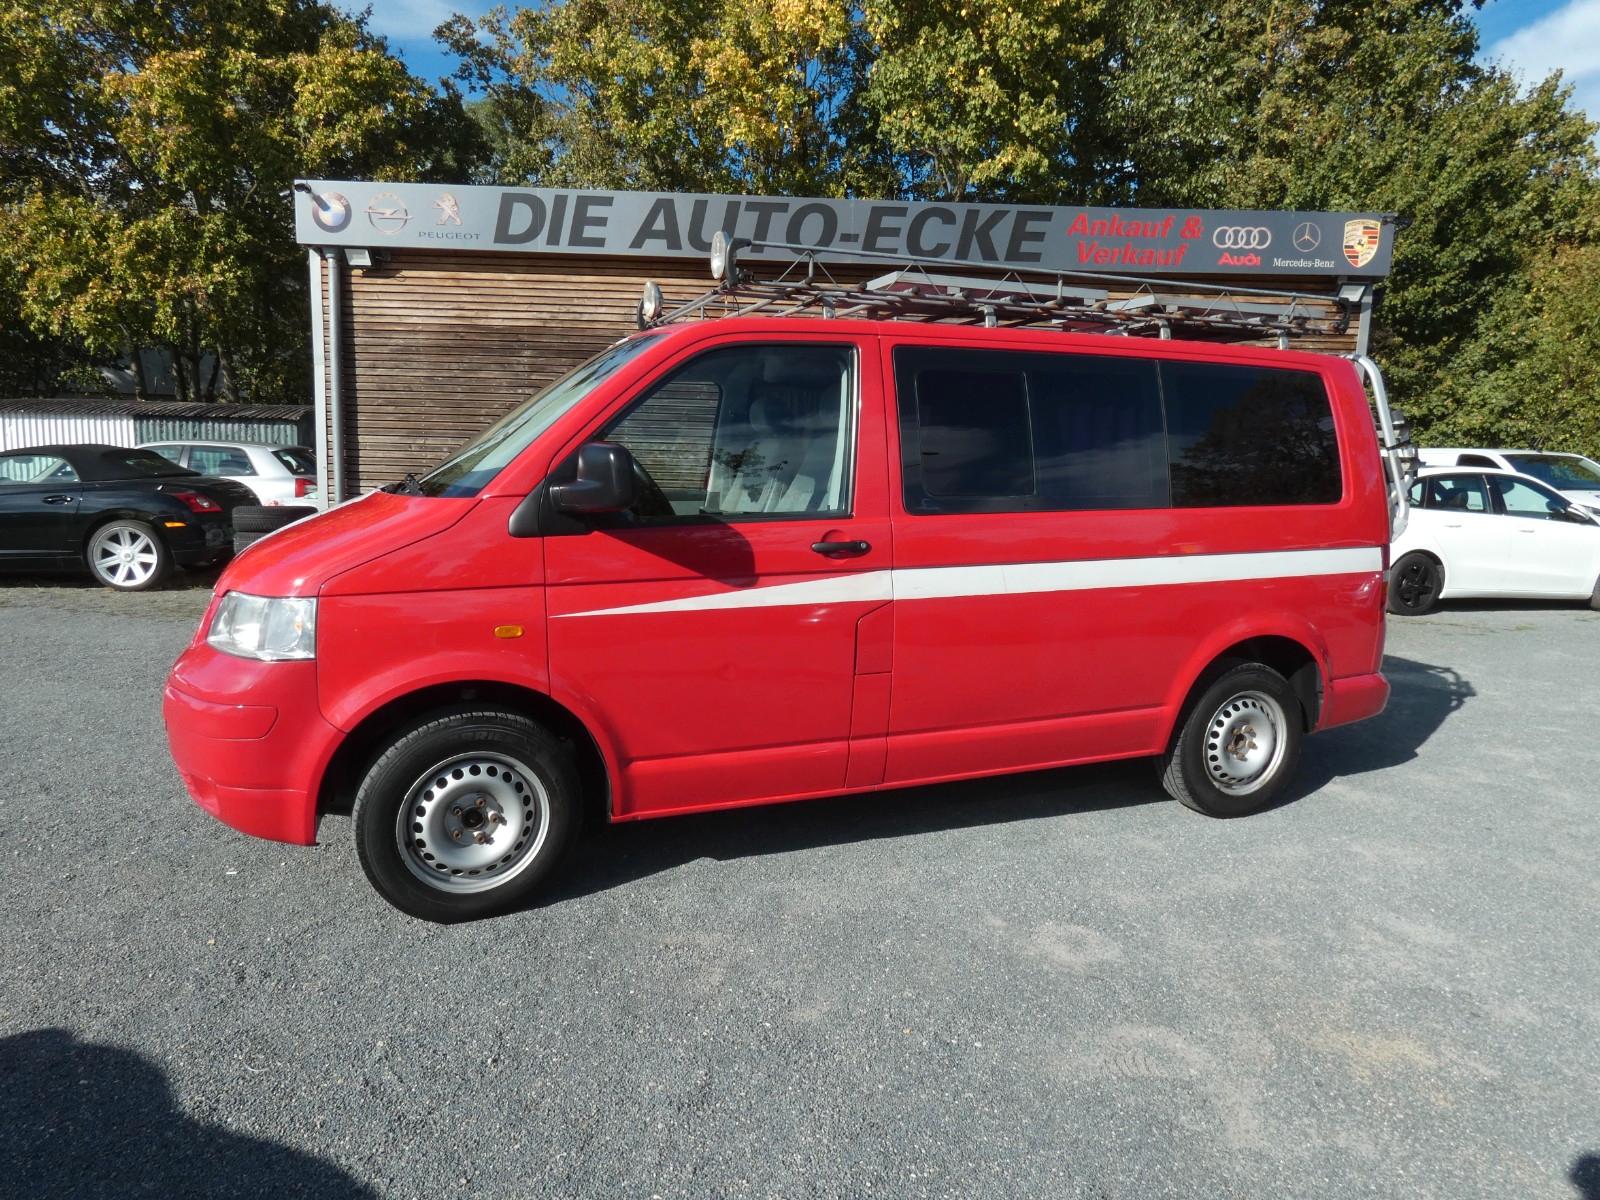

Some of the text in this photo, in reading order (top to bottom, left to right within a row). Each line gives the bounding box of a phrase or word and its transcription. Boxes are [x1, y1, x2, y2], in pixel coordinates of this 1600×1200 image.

[418, 231, 481, 241] PEUGEOT
[493, 192, 1054, 263] DIE AUTO-ECKE
[1066, 213, 1204, 240] Ankauf &
[1076, 240, 1189, 267] Verkauf
[1218, 252, 1262, 266] Audi
[1272, 257, 1335, 268] Mercedes-Benz
